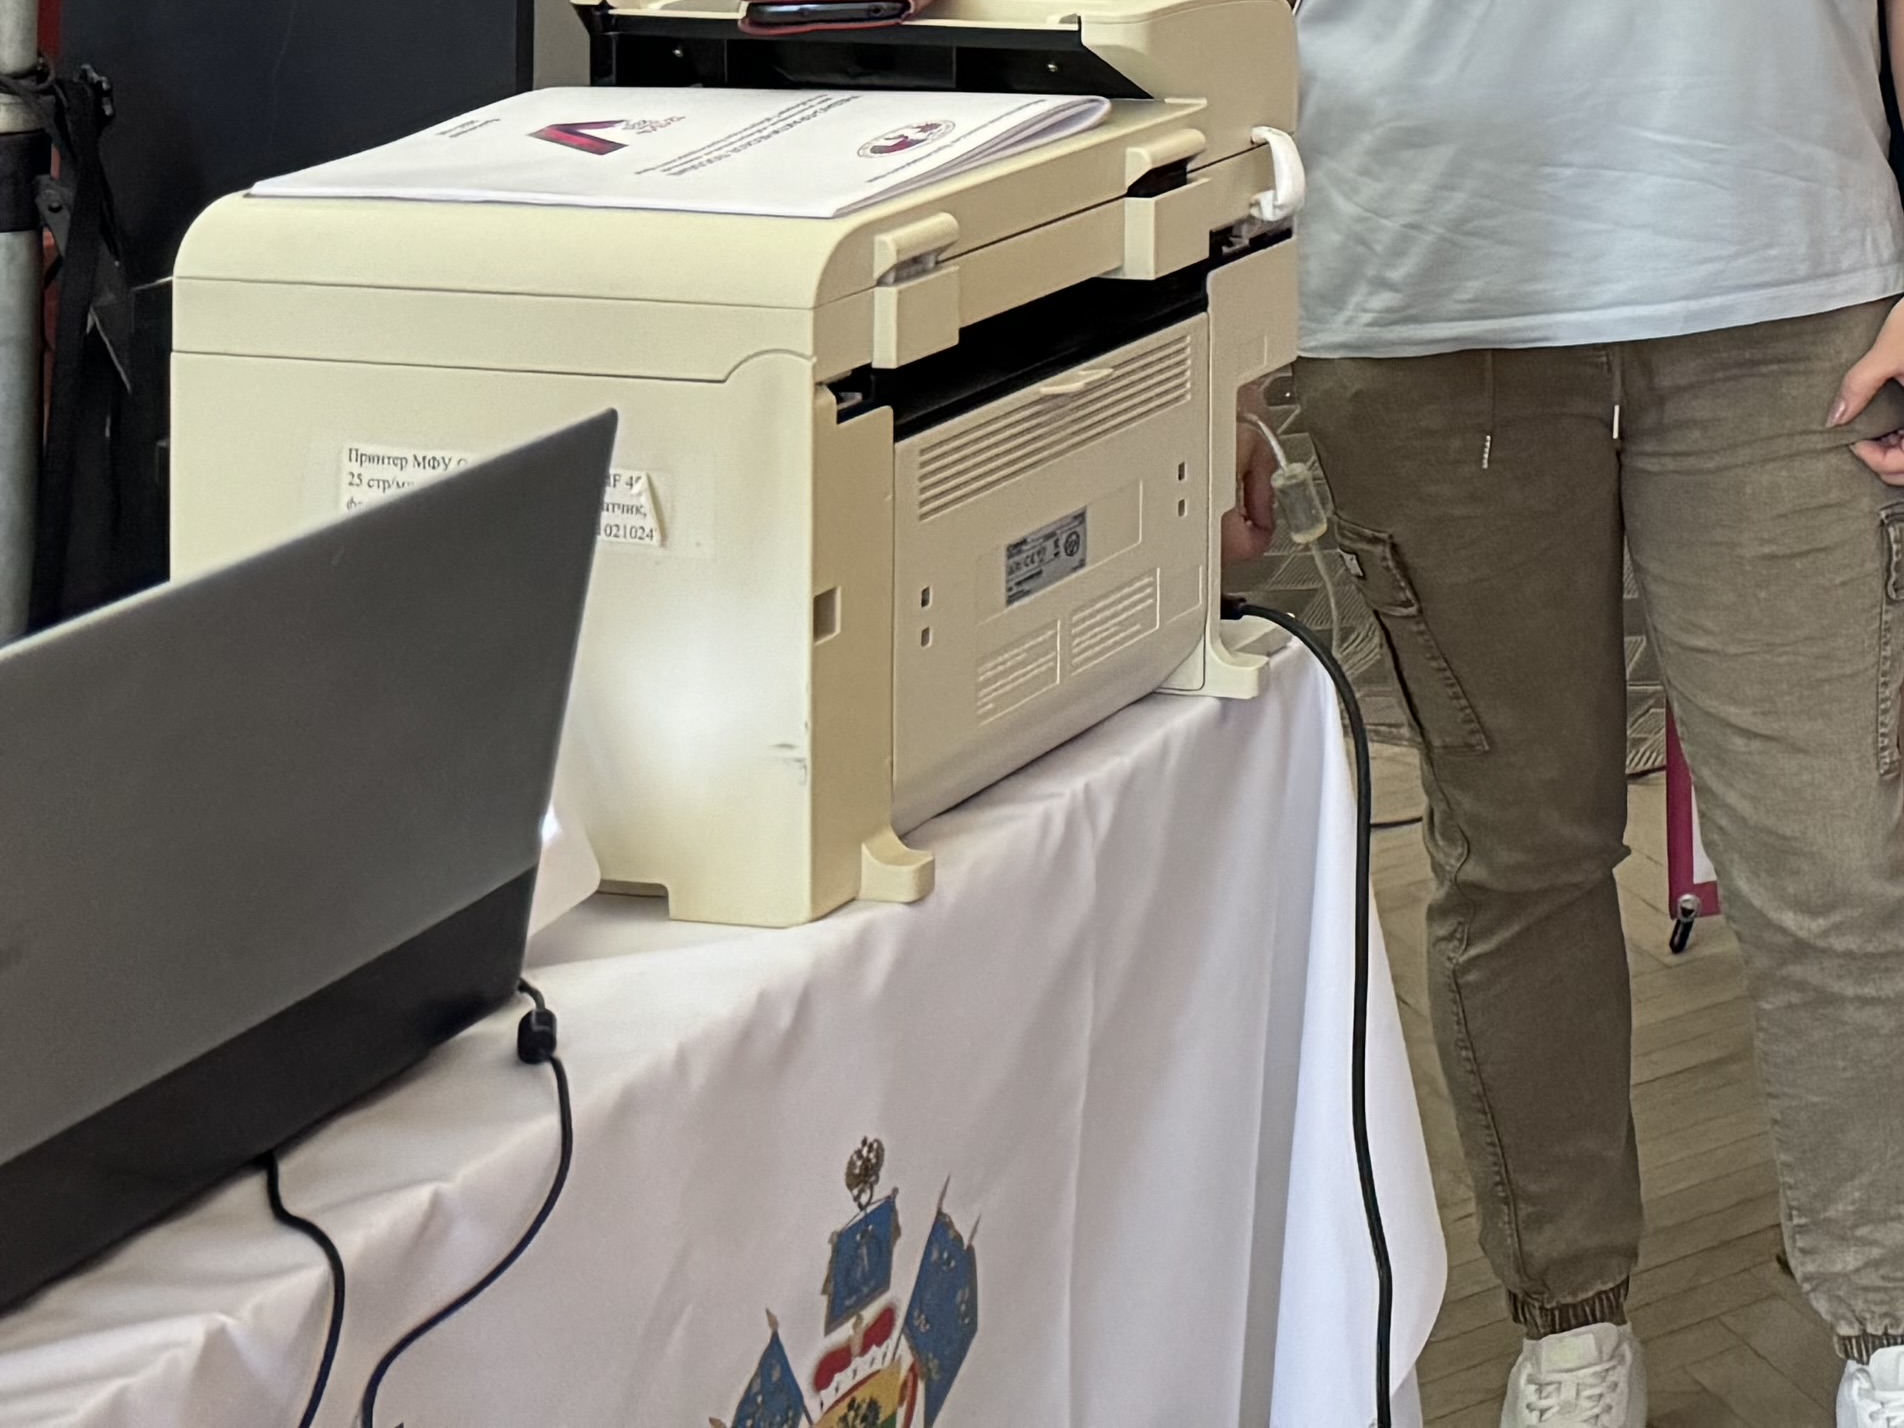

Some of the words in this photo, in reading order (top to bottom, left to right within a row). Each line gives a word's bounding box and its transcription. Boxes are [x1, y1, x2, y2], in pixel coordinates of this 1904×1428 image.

[348, 448, 408, 471] Принтер
[413, 454, 452, 471] МФУ
[348, 472, 363, 487] 25
